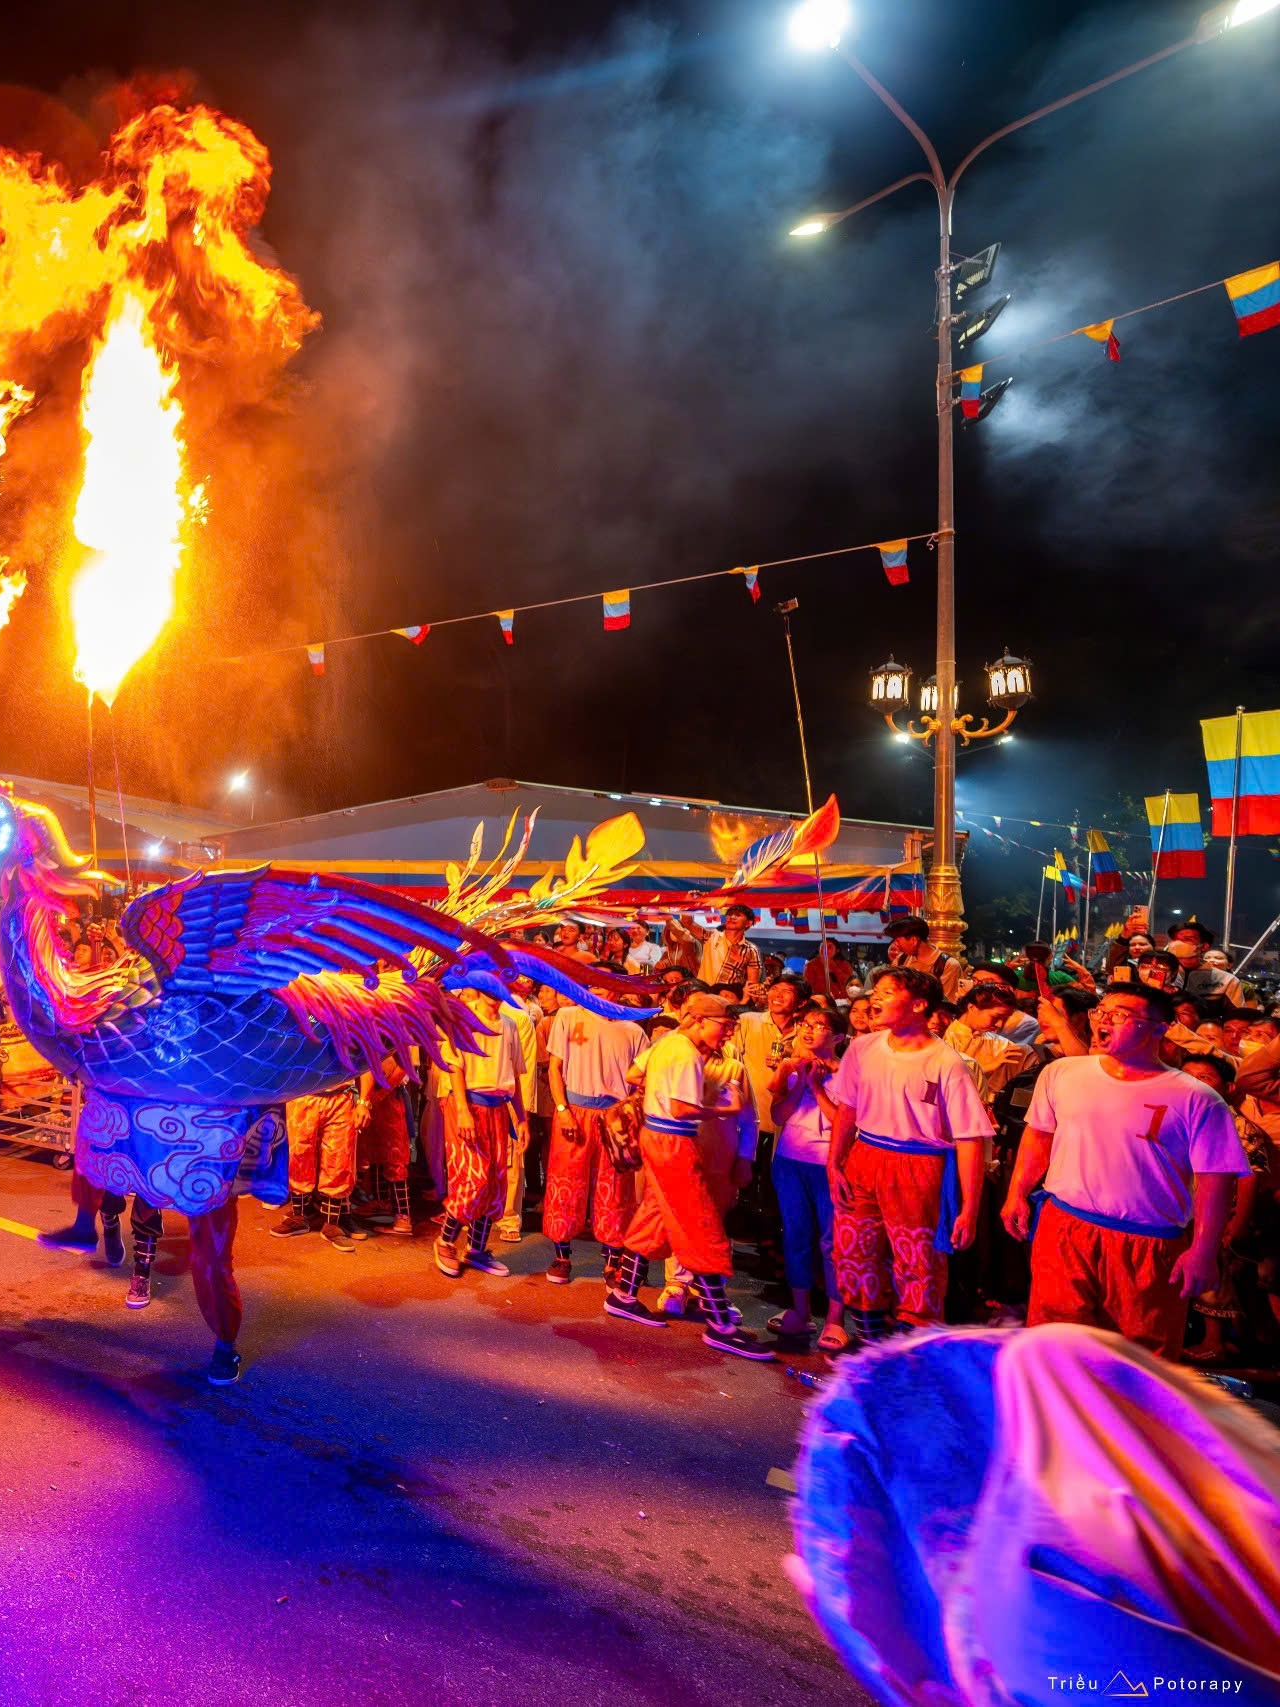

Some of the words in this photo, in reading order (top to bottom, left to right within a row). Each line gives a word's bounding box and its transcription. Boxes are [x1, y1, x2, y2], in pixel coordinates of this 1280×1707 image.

[569, 1021, 590, 1047] 4
[920, 1079, 939, 1107] 1
[1135, 1103, 1169, 1145] 1
